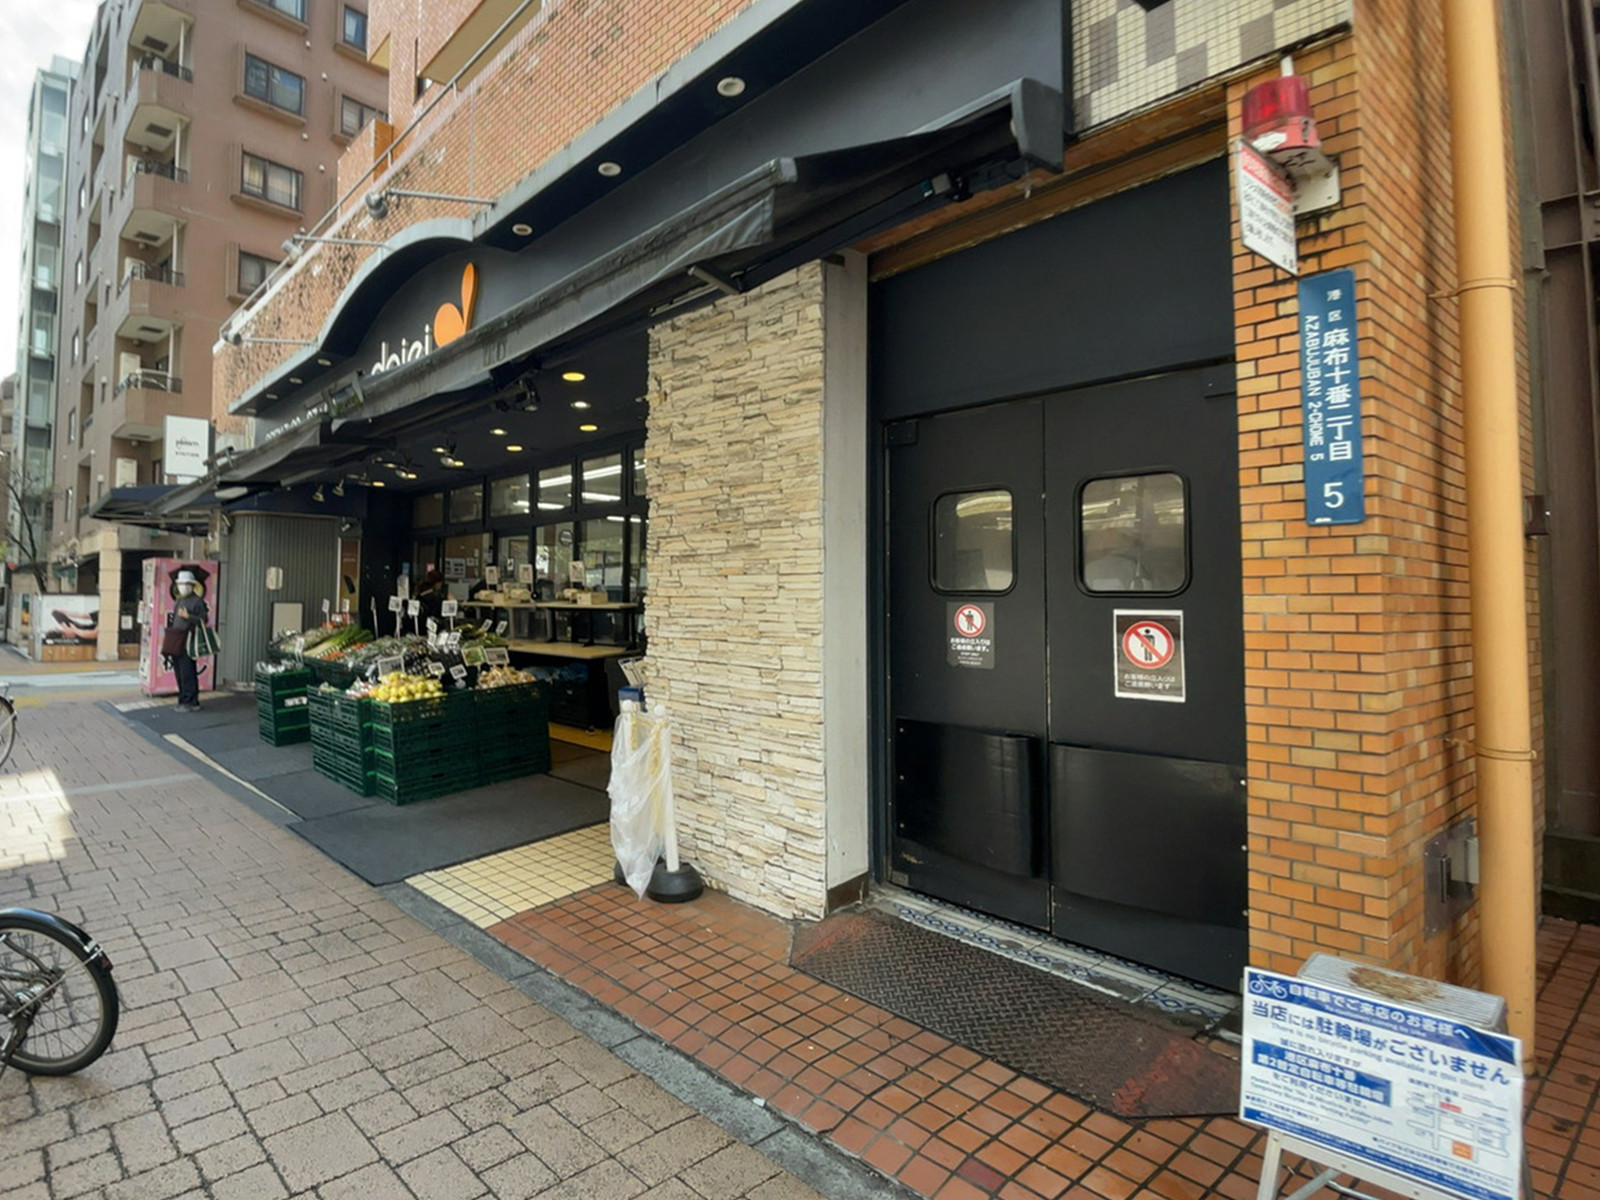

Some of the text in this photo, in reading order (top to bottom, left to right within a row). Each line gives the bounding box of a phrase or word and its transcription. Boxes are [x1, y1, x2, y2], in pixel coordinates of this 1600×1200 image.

[1304, 315, 1322, 397] AZABUJUBAN
[1322, 328, 1353, 462] 麻布十番二丁目
[1310, 452, 1324, 461] 5
[1323, 482, 1345, 509] 5
[1252, 998, 1509, 1085] 当店には駐輪場がございません
[1289, 984, 1469, 1041] 自転車でご来店のお客様へ
